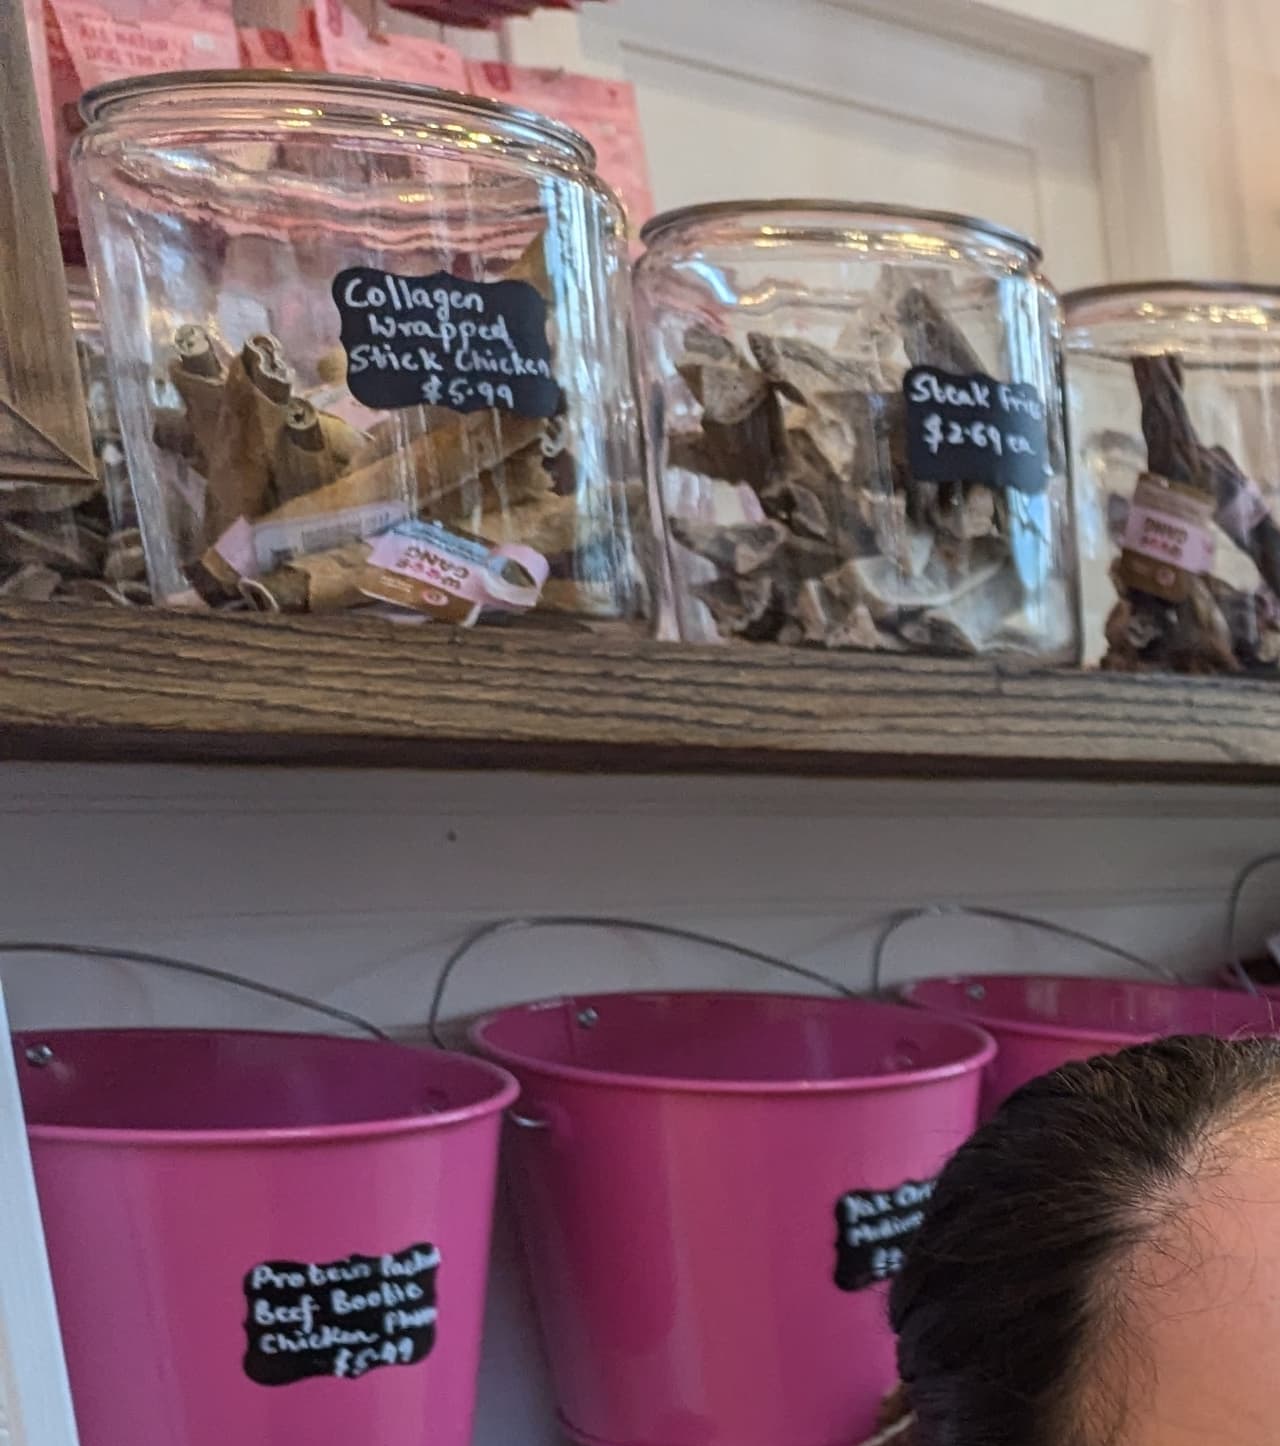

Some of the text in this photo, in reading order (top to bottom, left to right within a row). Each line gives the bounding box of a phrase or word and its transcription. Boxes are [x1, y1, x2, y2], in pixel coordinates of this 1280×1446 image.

[344, 275, 484, 322] Collagen
[368, 313, 516, 353] Wrapped
[350, 343, 550, 376] Stick Chicken
[421, 374, 514, 408] $5.99
[910, 372, 990, 408] Steak
[255, 1294, 320, 1333] Beef
